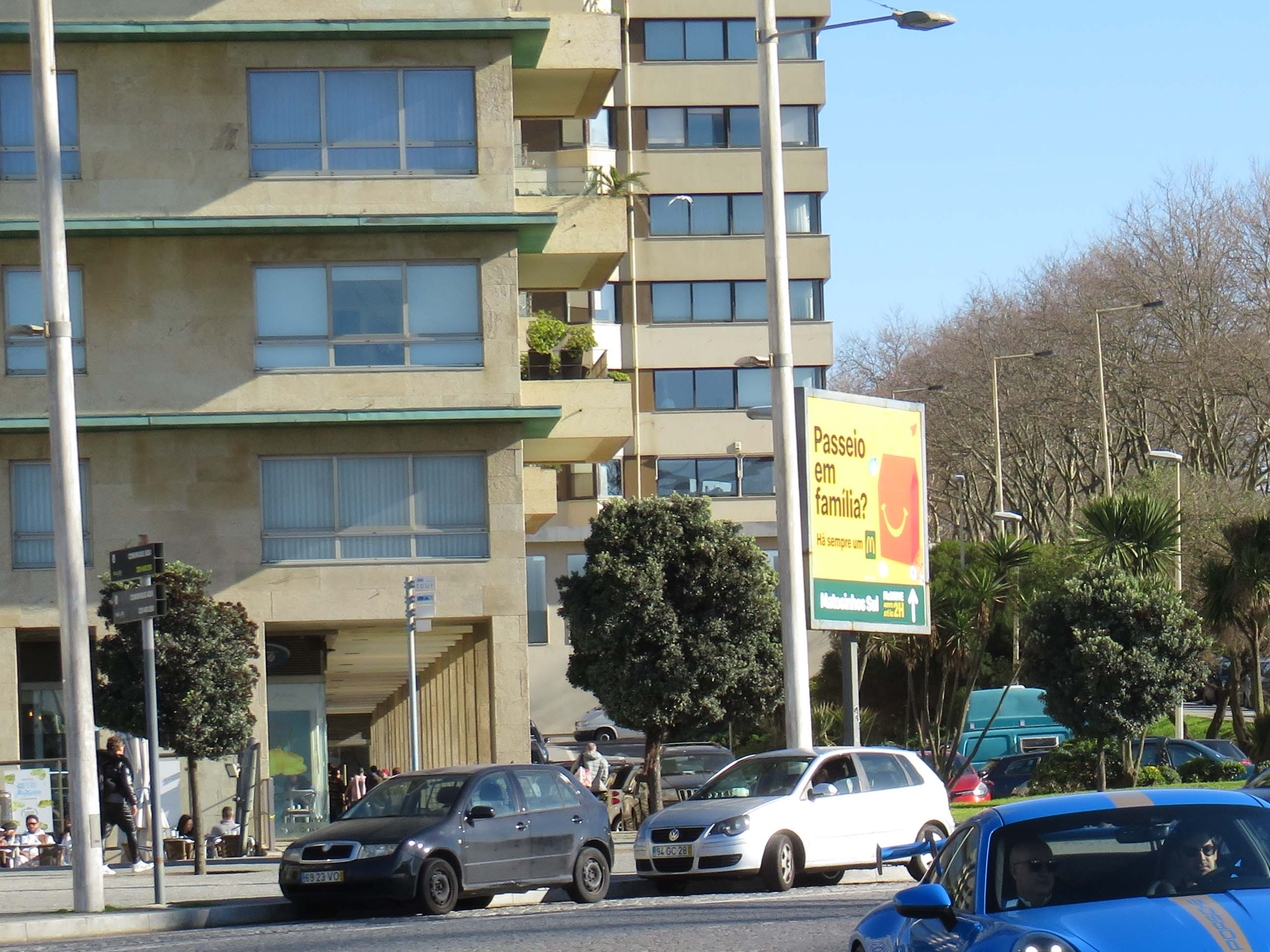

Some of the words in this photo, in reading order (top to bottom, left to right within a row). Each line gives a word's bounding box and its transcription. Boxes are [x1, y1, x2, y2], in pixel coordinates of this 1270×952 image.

[814, 425, 866, 459] Passeio
[814, 461, 836, 485] em
[815, 486, 868, 520] família?
[816, 532, 826, 546] Há
[827, 535, 852, 551] sempre
[853, 537, 864, 550] um
